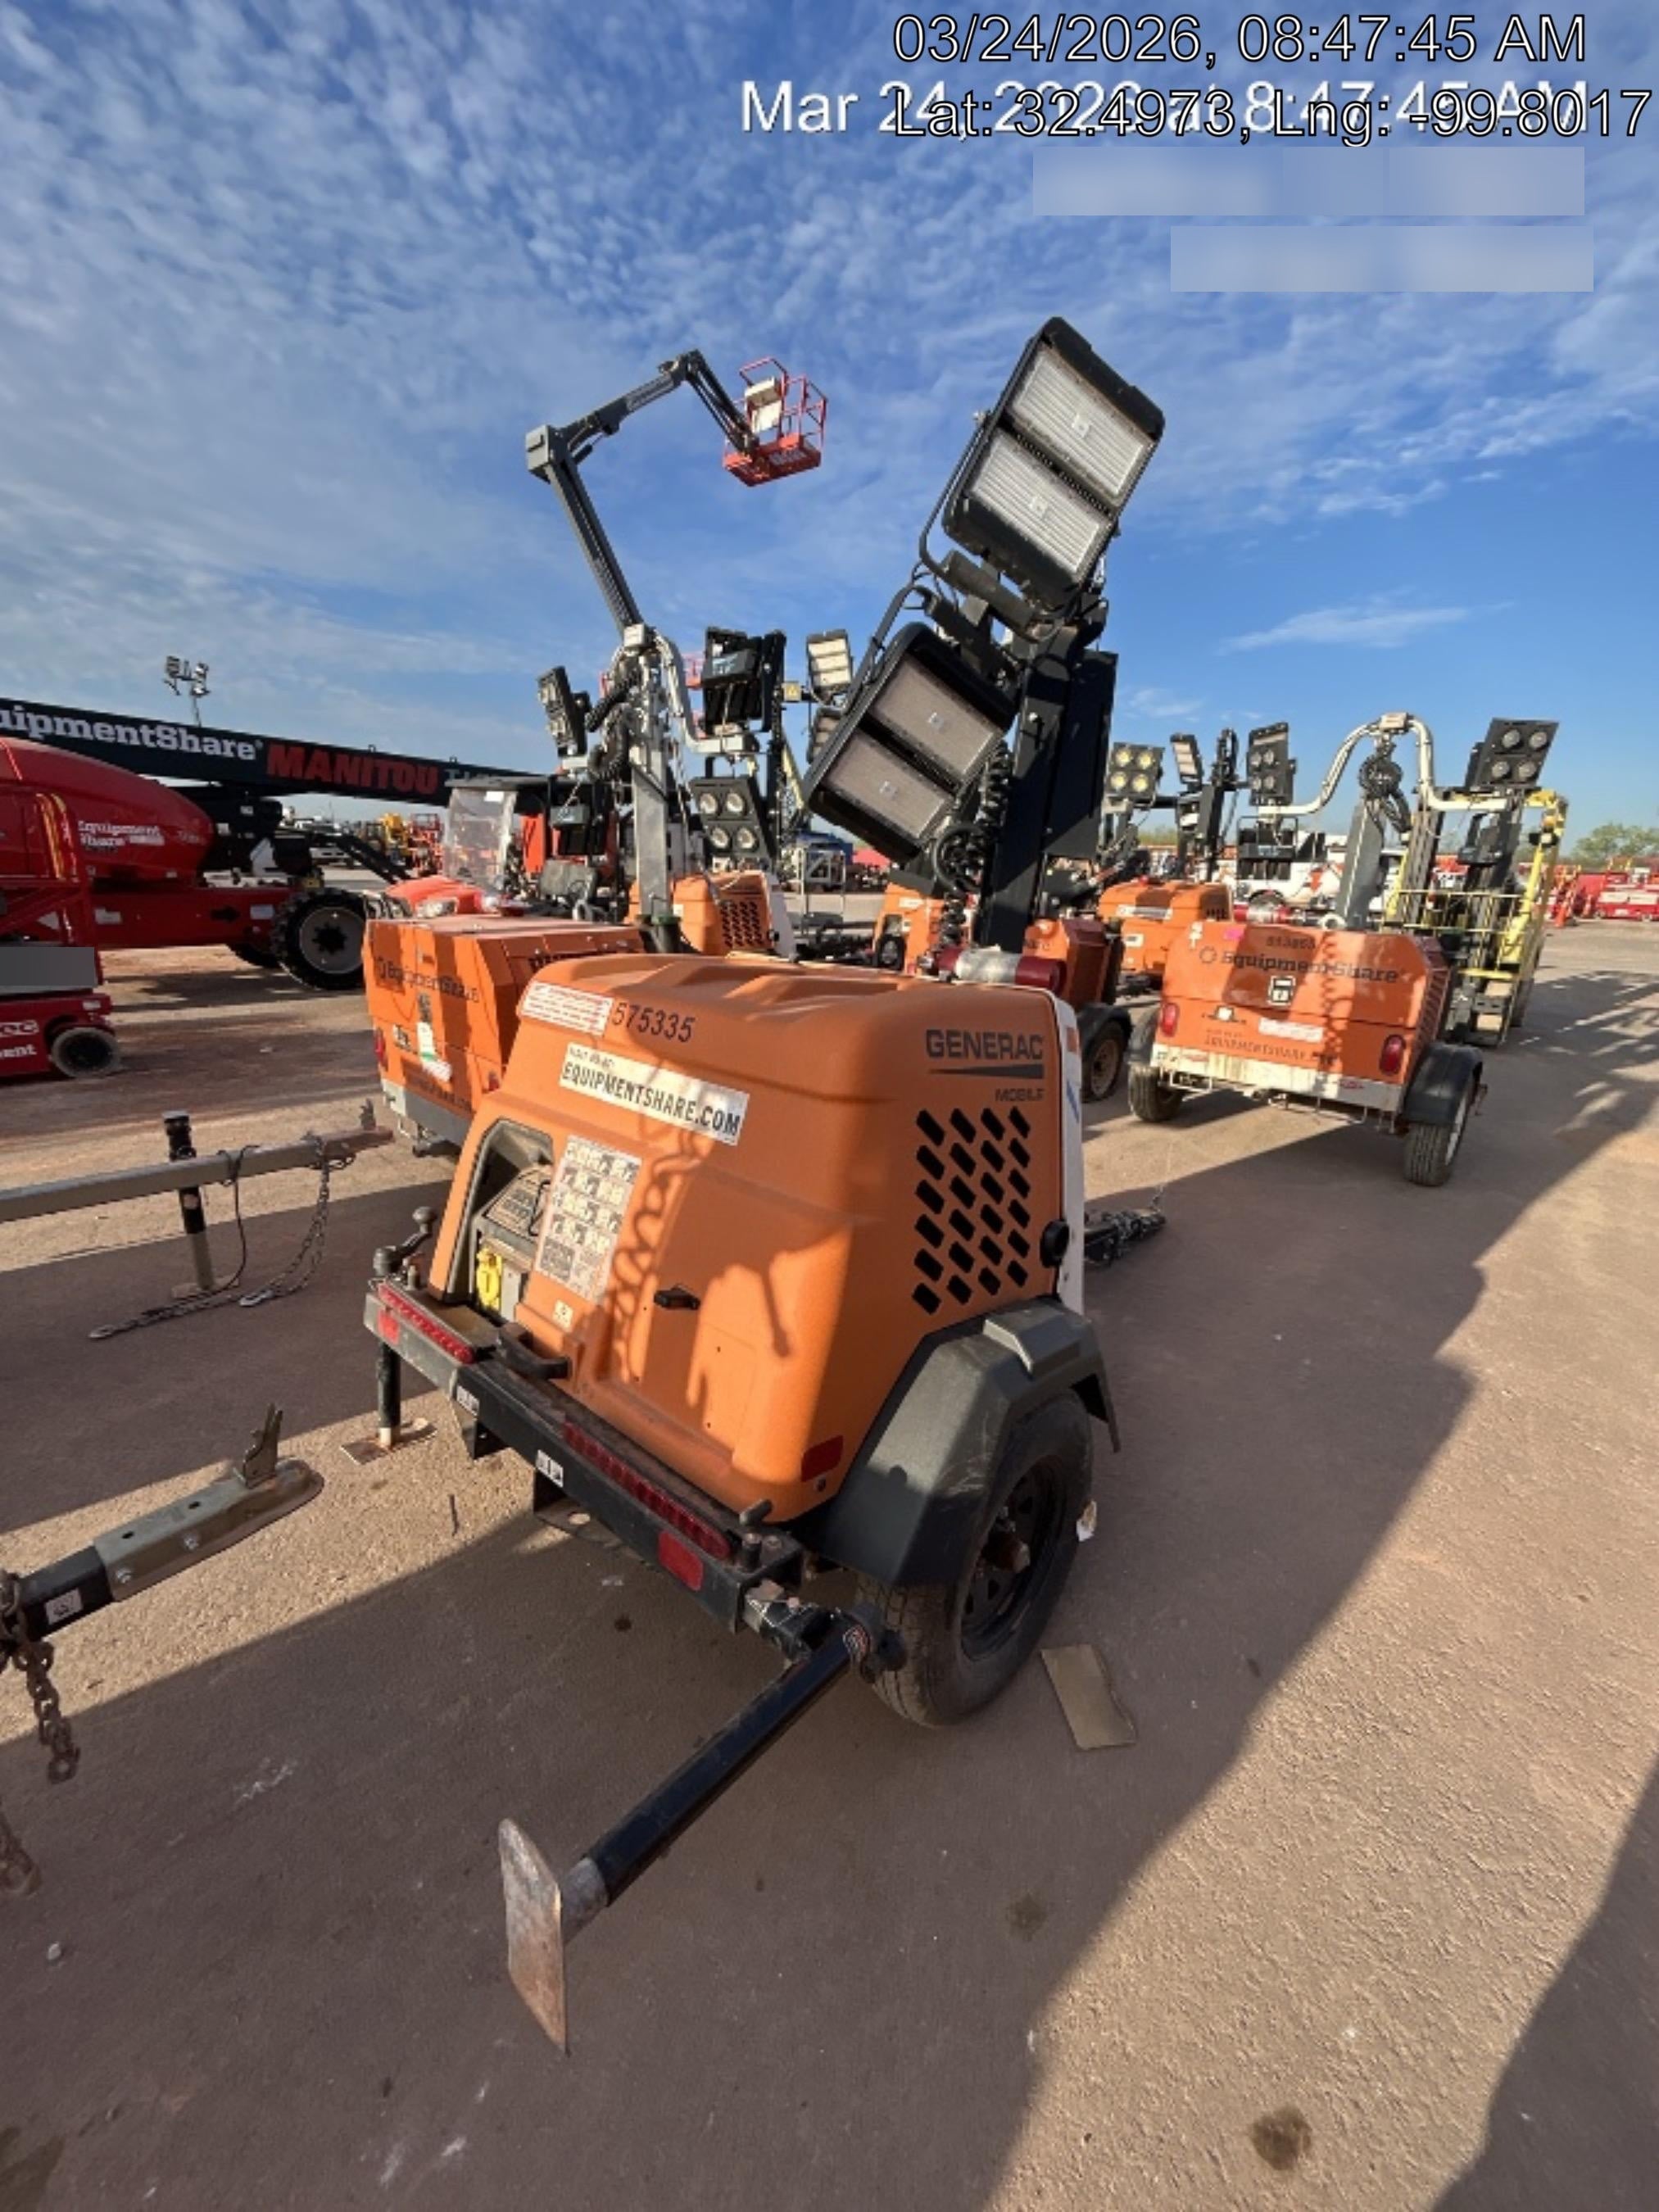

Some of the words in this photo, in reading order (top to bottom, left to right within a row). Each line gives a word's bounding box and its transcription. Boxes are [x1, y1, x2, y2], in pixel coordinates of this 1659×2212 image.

[266, 741, 439, 795] MANITOU
[611, 1001, 696, 1043] 575335
[926, 1029, 1044, 1060] GENERAC
[562, 1061, 741, 1136] EQUIPMENTSHARE.COM
[995, 1088, 1045, 1102] MOBILE
